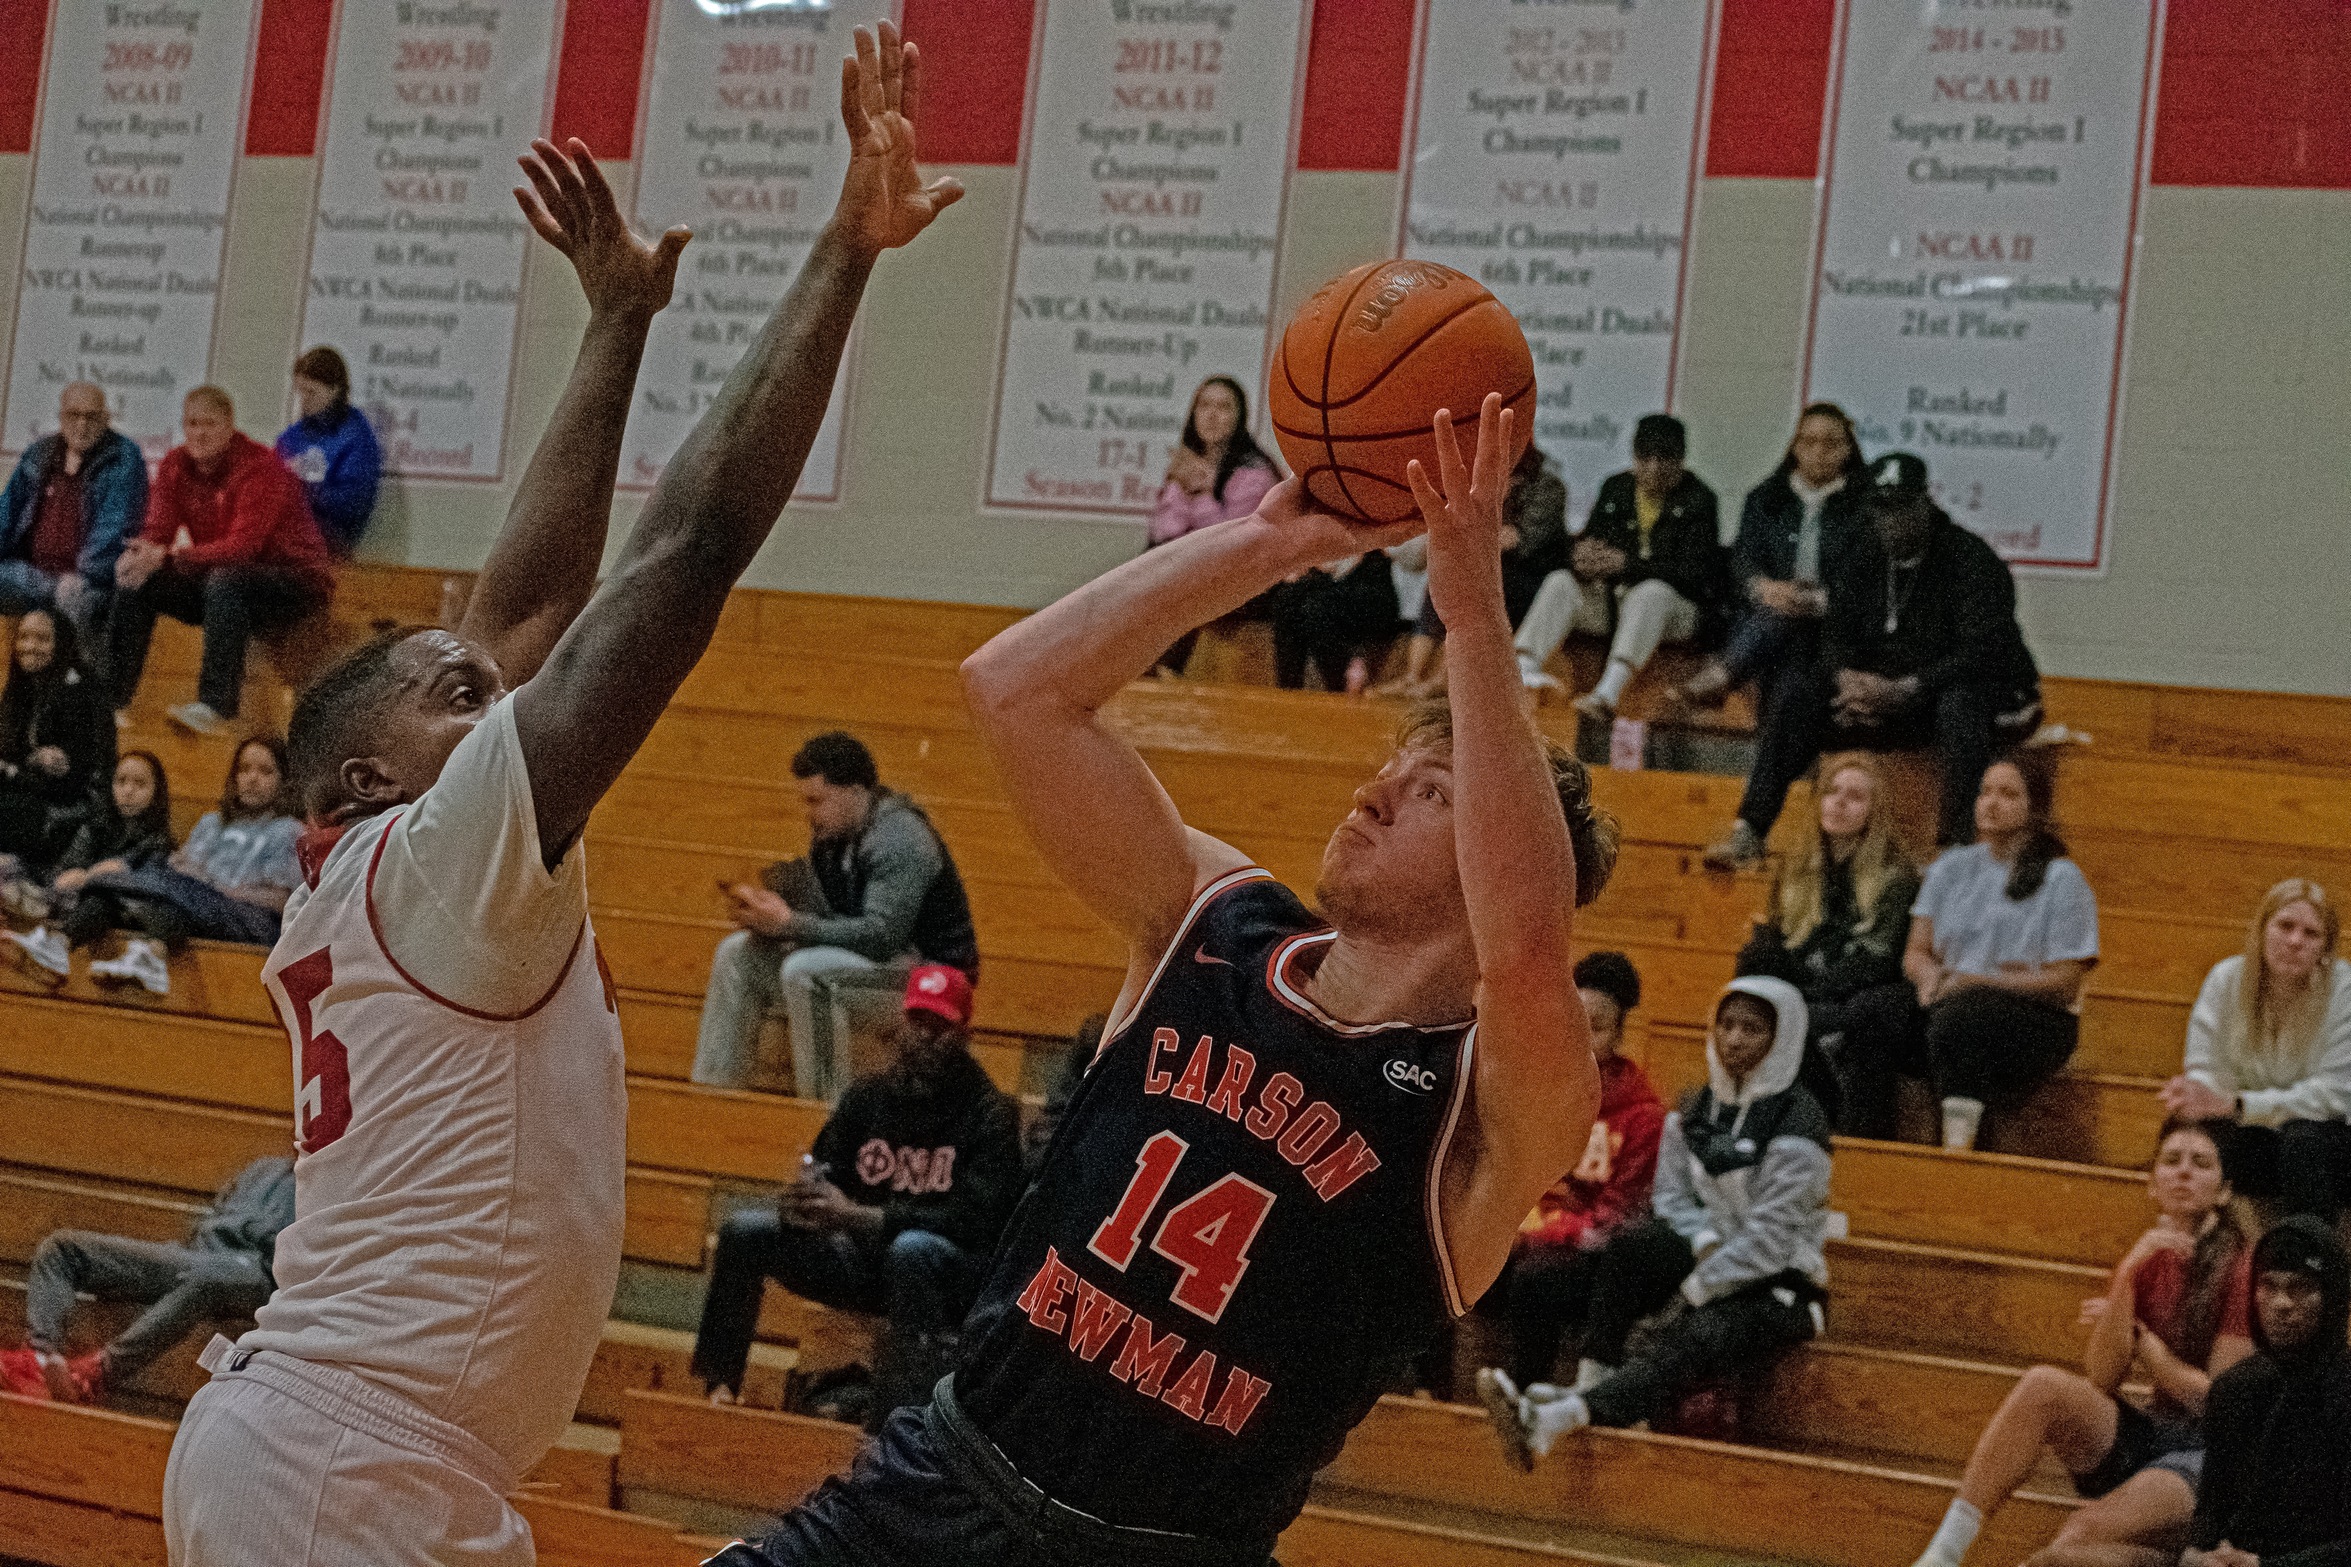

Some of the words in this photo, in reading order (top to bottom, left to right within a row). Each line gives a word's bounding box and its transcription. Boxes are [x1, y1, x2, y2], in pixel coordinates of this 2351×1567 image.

[1113, 39, 1222, 73] 2011-12
[1511, 59, 1586, 84] NCAA
[104, 81, 160, 104] NCAA
[395, 82, 458, 105] NCAA
[717, 87, 784, 111] NCAA
[1112, 85, 1187, 112] NCAA
[1467, 87, 1537, 121] Super
[1544, 87, 1630, 120] Region
[1932, 76, 2020, 104] NCAA
[75, 114, 123, 138] Super
[129, 114, 190, 139] Region
[365, 113, 417, 142] Super
[422, 114, 488, 142] Region
[685, 118, 742, 149] Super
[747, 120, 819, 150] Region
[1077, 120, 1140, 153] Super
[1146, 120, 1226, 151] Region
[1889, 113, 1965, 149] Super
[1973, 114, 2067, 150] Region
[1483, 127, 1622, 160] Champions
[85, 145, 182, 172] Champions
[375, 146, 482, 175] Champions
[698, 154, 812, 185] Champions
[1090, 157, 1218, 188] Champions
[92, 175, 149, 198] NCAA
[1906, 156, 2058, 192] Champions
[383, 179, 443, 203] NCAA
[706, 187, 773, 212] NCAA
[1101, 190, 1175, 216] NCAA
[1497, 180, 1574, 208] NCAA
[33, 205, 97, 226] National
[101, 204, 226, 234] Championships
[320, 210, 391, 232] National
[394, 210, 527, 241] Championships
[408, 243, 456, 266] Place
[1021, 222, 1110, 248] National
[1113, 222, 1277, 262] Championships
[1406, 222, 1503, 248] National
[1506, 222, 1683, 260] Championships
[1916, 233, 2004, 261] NCAA
[88, 269, 162, 293] National
[1134, 256, 1195, 284] Place
[1527, 258, 1593, 287] Place
[1824, 269, 1926, 298] National
[379, 277, 458, 301] National
[1016, 296, 1091, 321] NWCA
[1098, 298, 1195, 326] National
[1956, 309, 2030, 339] Place
[79, 332, 145, 356] Ranked
[367, 343, 441, 367] Ranked
[1087, 369, 1174, 399] Ranked
[1906, 385, 2008, 416] Ranked
[1923, 418, 2058, 461] Nationally
[1024, 469, 1113, 500] Season
[1390, 1059, 1438, 1092] SAC
[1144, 1027, 1382, 1202] CARSON
[1086, 1129, 1278, 1325] 14
